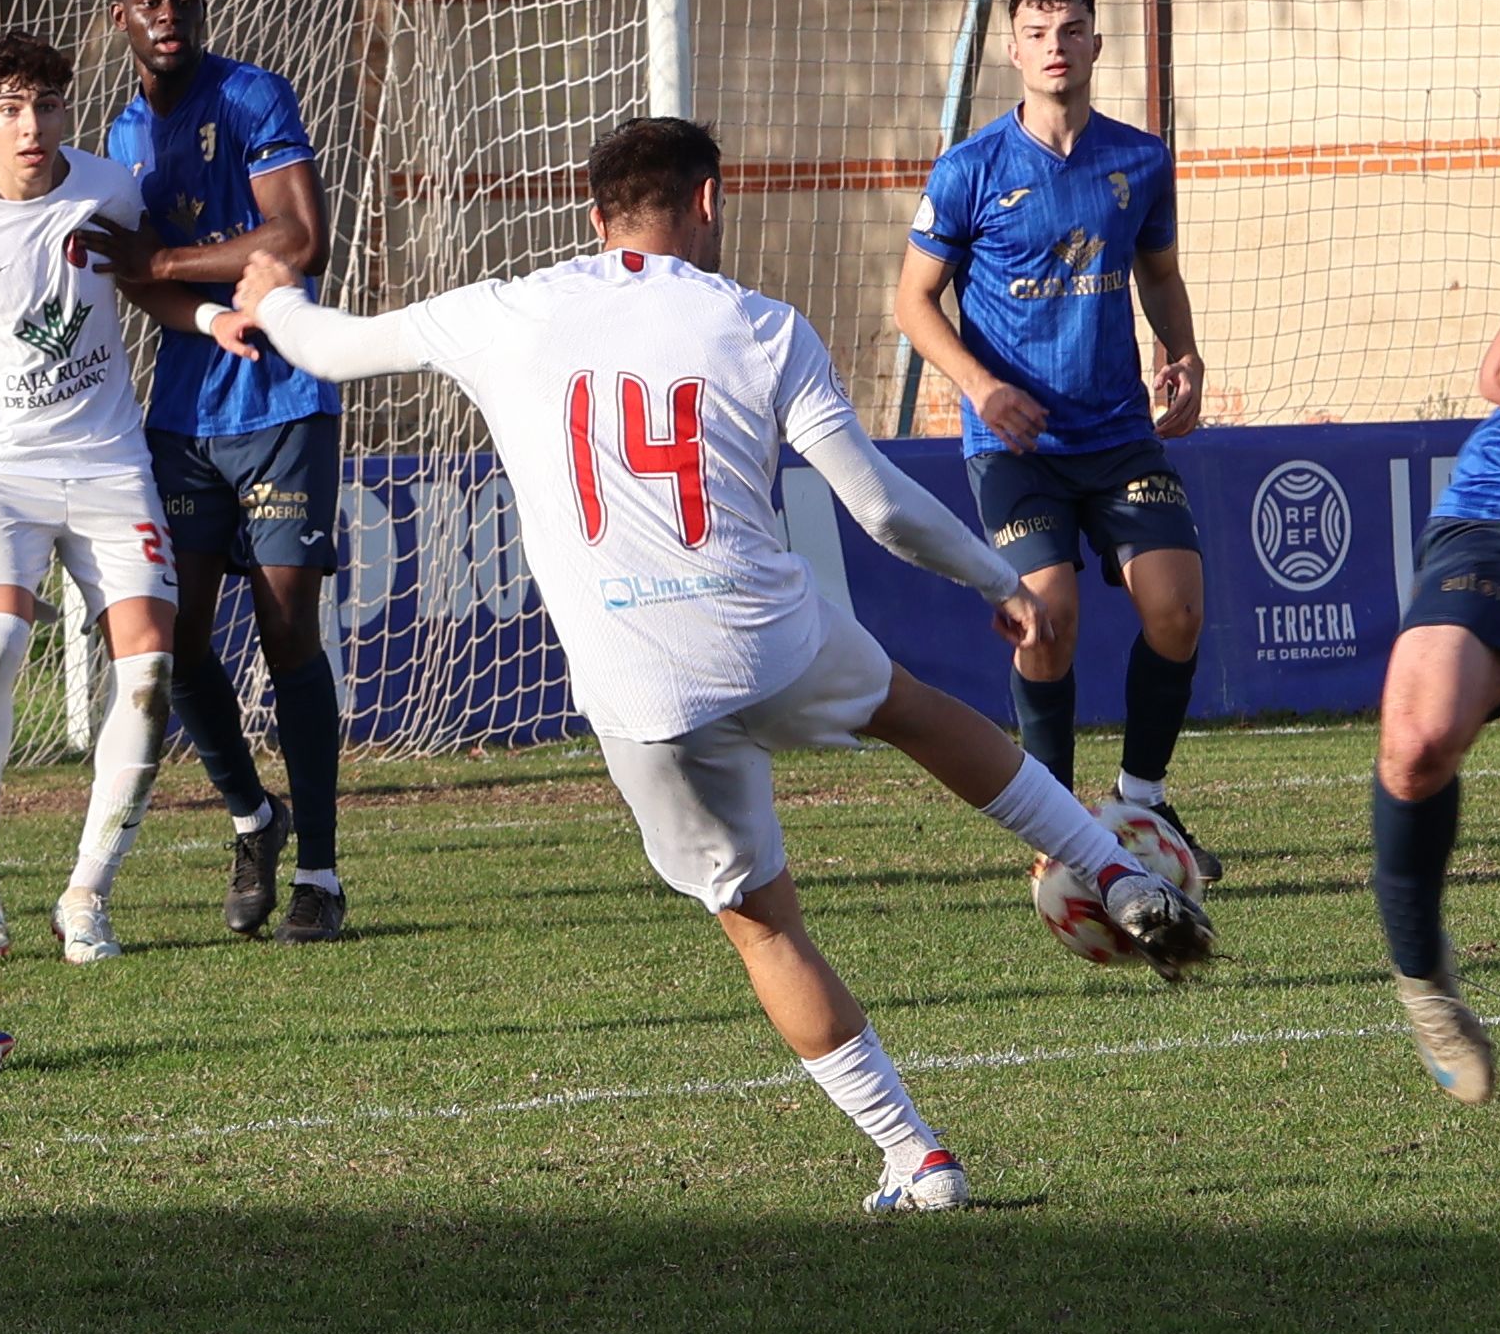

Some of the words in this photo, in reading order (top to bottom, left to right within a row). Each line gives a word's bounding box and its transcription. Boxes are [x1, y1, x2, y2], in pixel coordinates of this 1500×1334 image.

[4, 396, 25, 409] DE
[27, 368, 107, 409] SALAMANC
[6, 370, 54, 395] CAJA
[564, 369, 712, 551] 14
[1255, 603, 1357, 644] TERCERA
